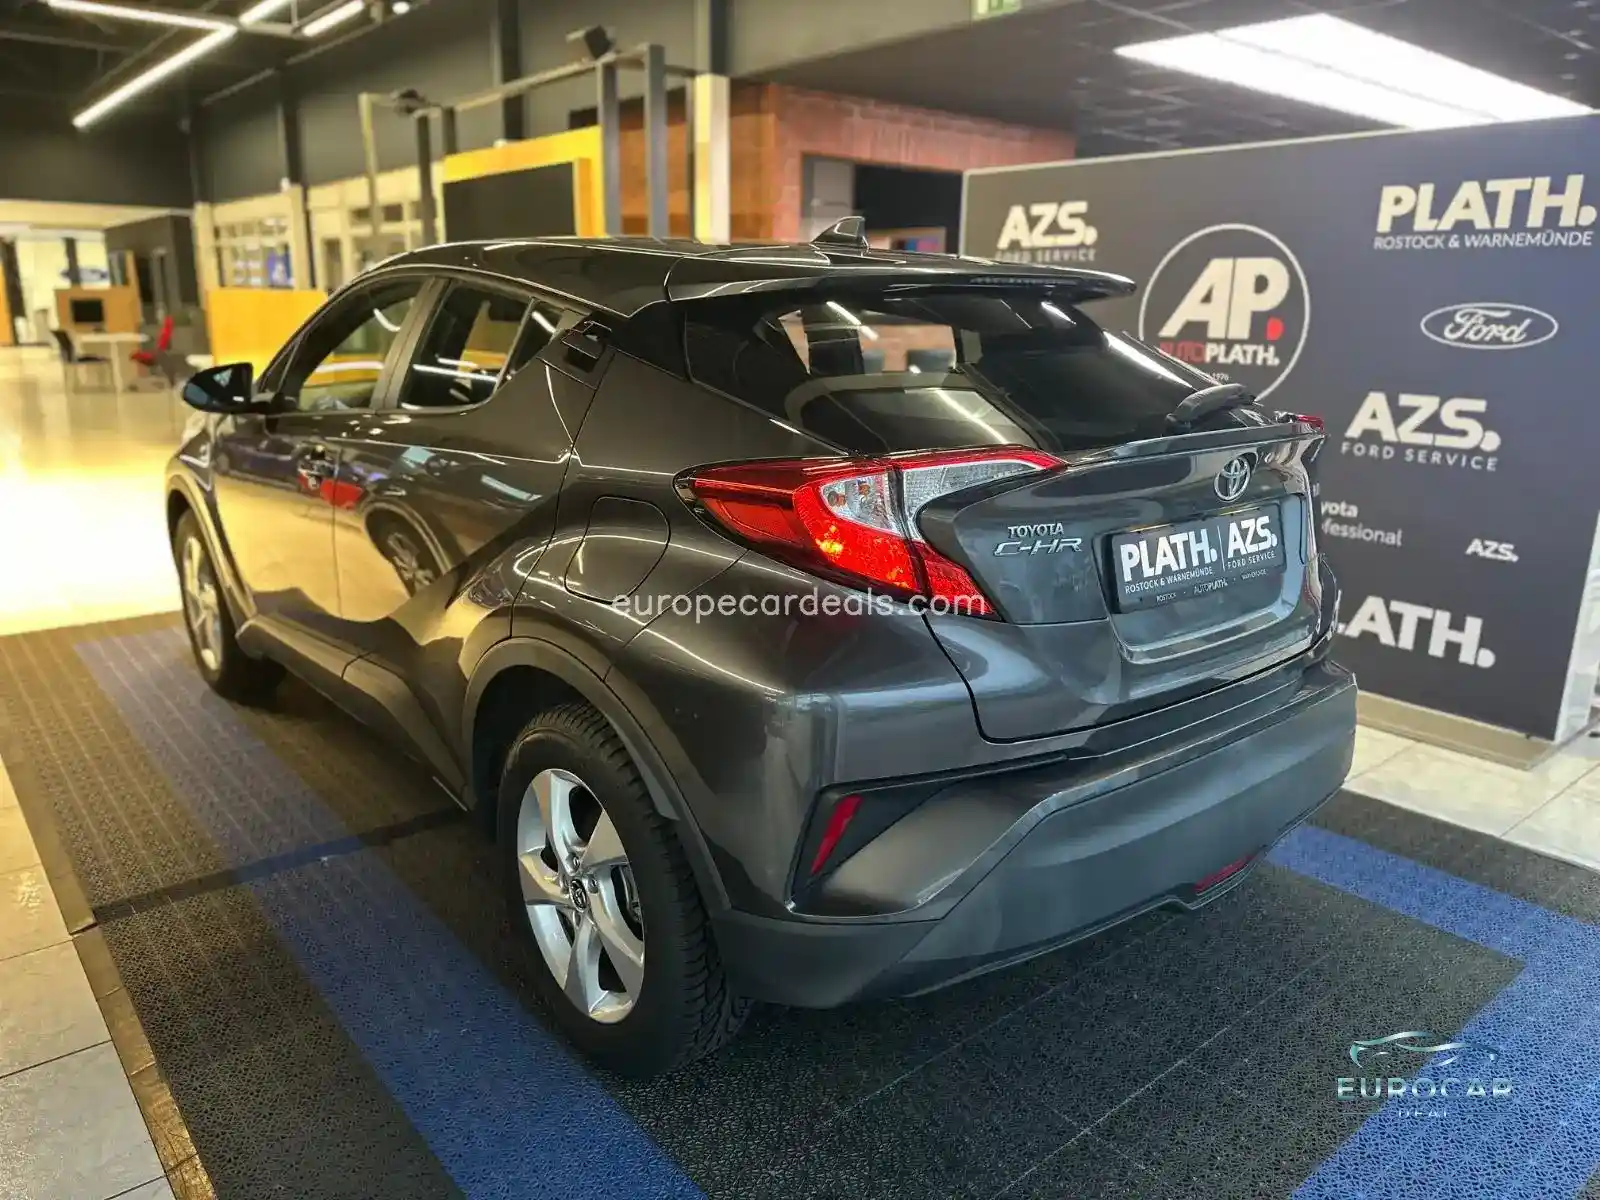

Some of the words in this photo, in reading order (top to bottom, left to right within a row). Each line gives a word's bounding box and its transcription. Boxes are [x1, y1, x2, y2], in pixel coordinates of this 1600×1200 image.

[1376, 174, 1598, 233] PLATH.
[997, 200, 1098, 249] AZS.
[1374, 234, 1445, 250] ROSTOCK
[1448, 233, 1460, 249] &
[1463, 229, 1594, 248] WARNEMÜNDE
[1158, 256, 1290, 341] AP.
[1444, 308, 1532, 343] Ford
[1344, 391, 1501, 452] AZS.
[1340, 441, 1395, 460] FORD
[1404, 448, 1499, 472] SERVICE
[1321, 500, 1359, 518] yota
[1007, 522, 1065, 539] TOYOTA
[1321, 518, 1403, 547] fessional
[994, 538, 1083, 557] C-HR
[1120, 528, 1218, 582] PLATH.
[1227, 515, 1278, 559] AZS.
[1227, 560, 1247, 570] FORD
[1248, 551, 1276, 565] SERVICE
[1465, 538, 1520, 562] AZS.
[1125, 578, 1160, 595] ROSTOCK
[1337, 595, 1496, 668] ATH.
